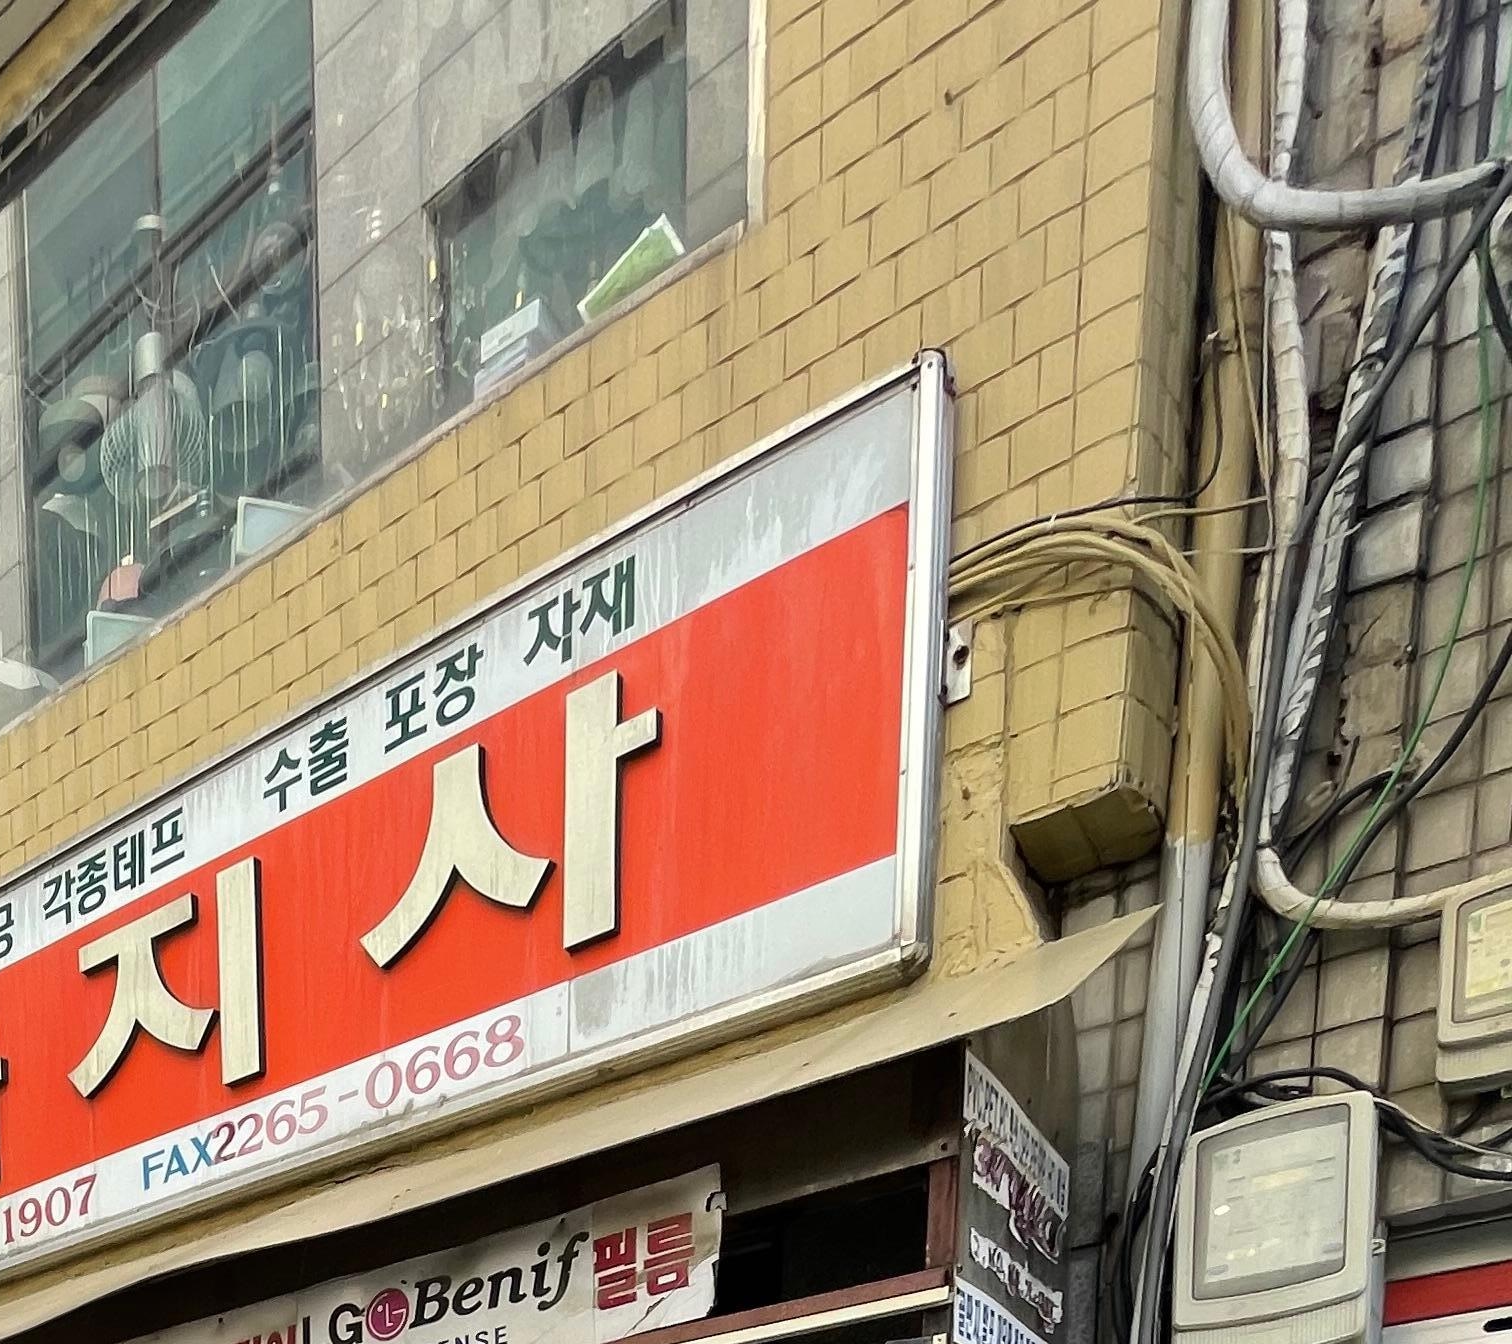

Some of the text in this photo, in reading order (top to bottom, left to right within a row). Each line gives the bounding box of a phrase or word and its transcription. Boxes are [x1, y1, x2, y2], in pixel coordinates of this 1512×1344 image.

[42, 806, 186, 926] 각종테프
[262, 716, 349, 813] 수출
[384, 638, 484, 757] 포장
[522, 555, 637, 668] 자재
[409, 1230, 589, 1330] Benif
[591, 1212, 695, 1312] 필름
